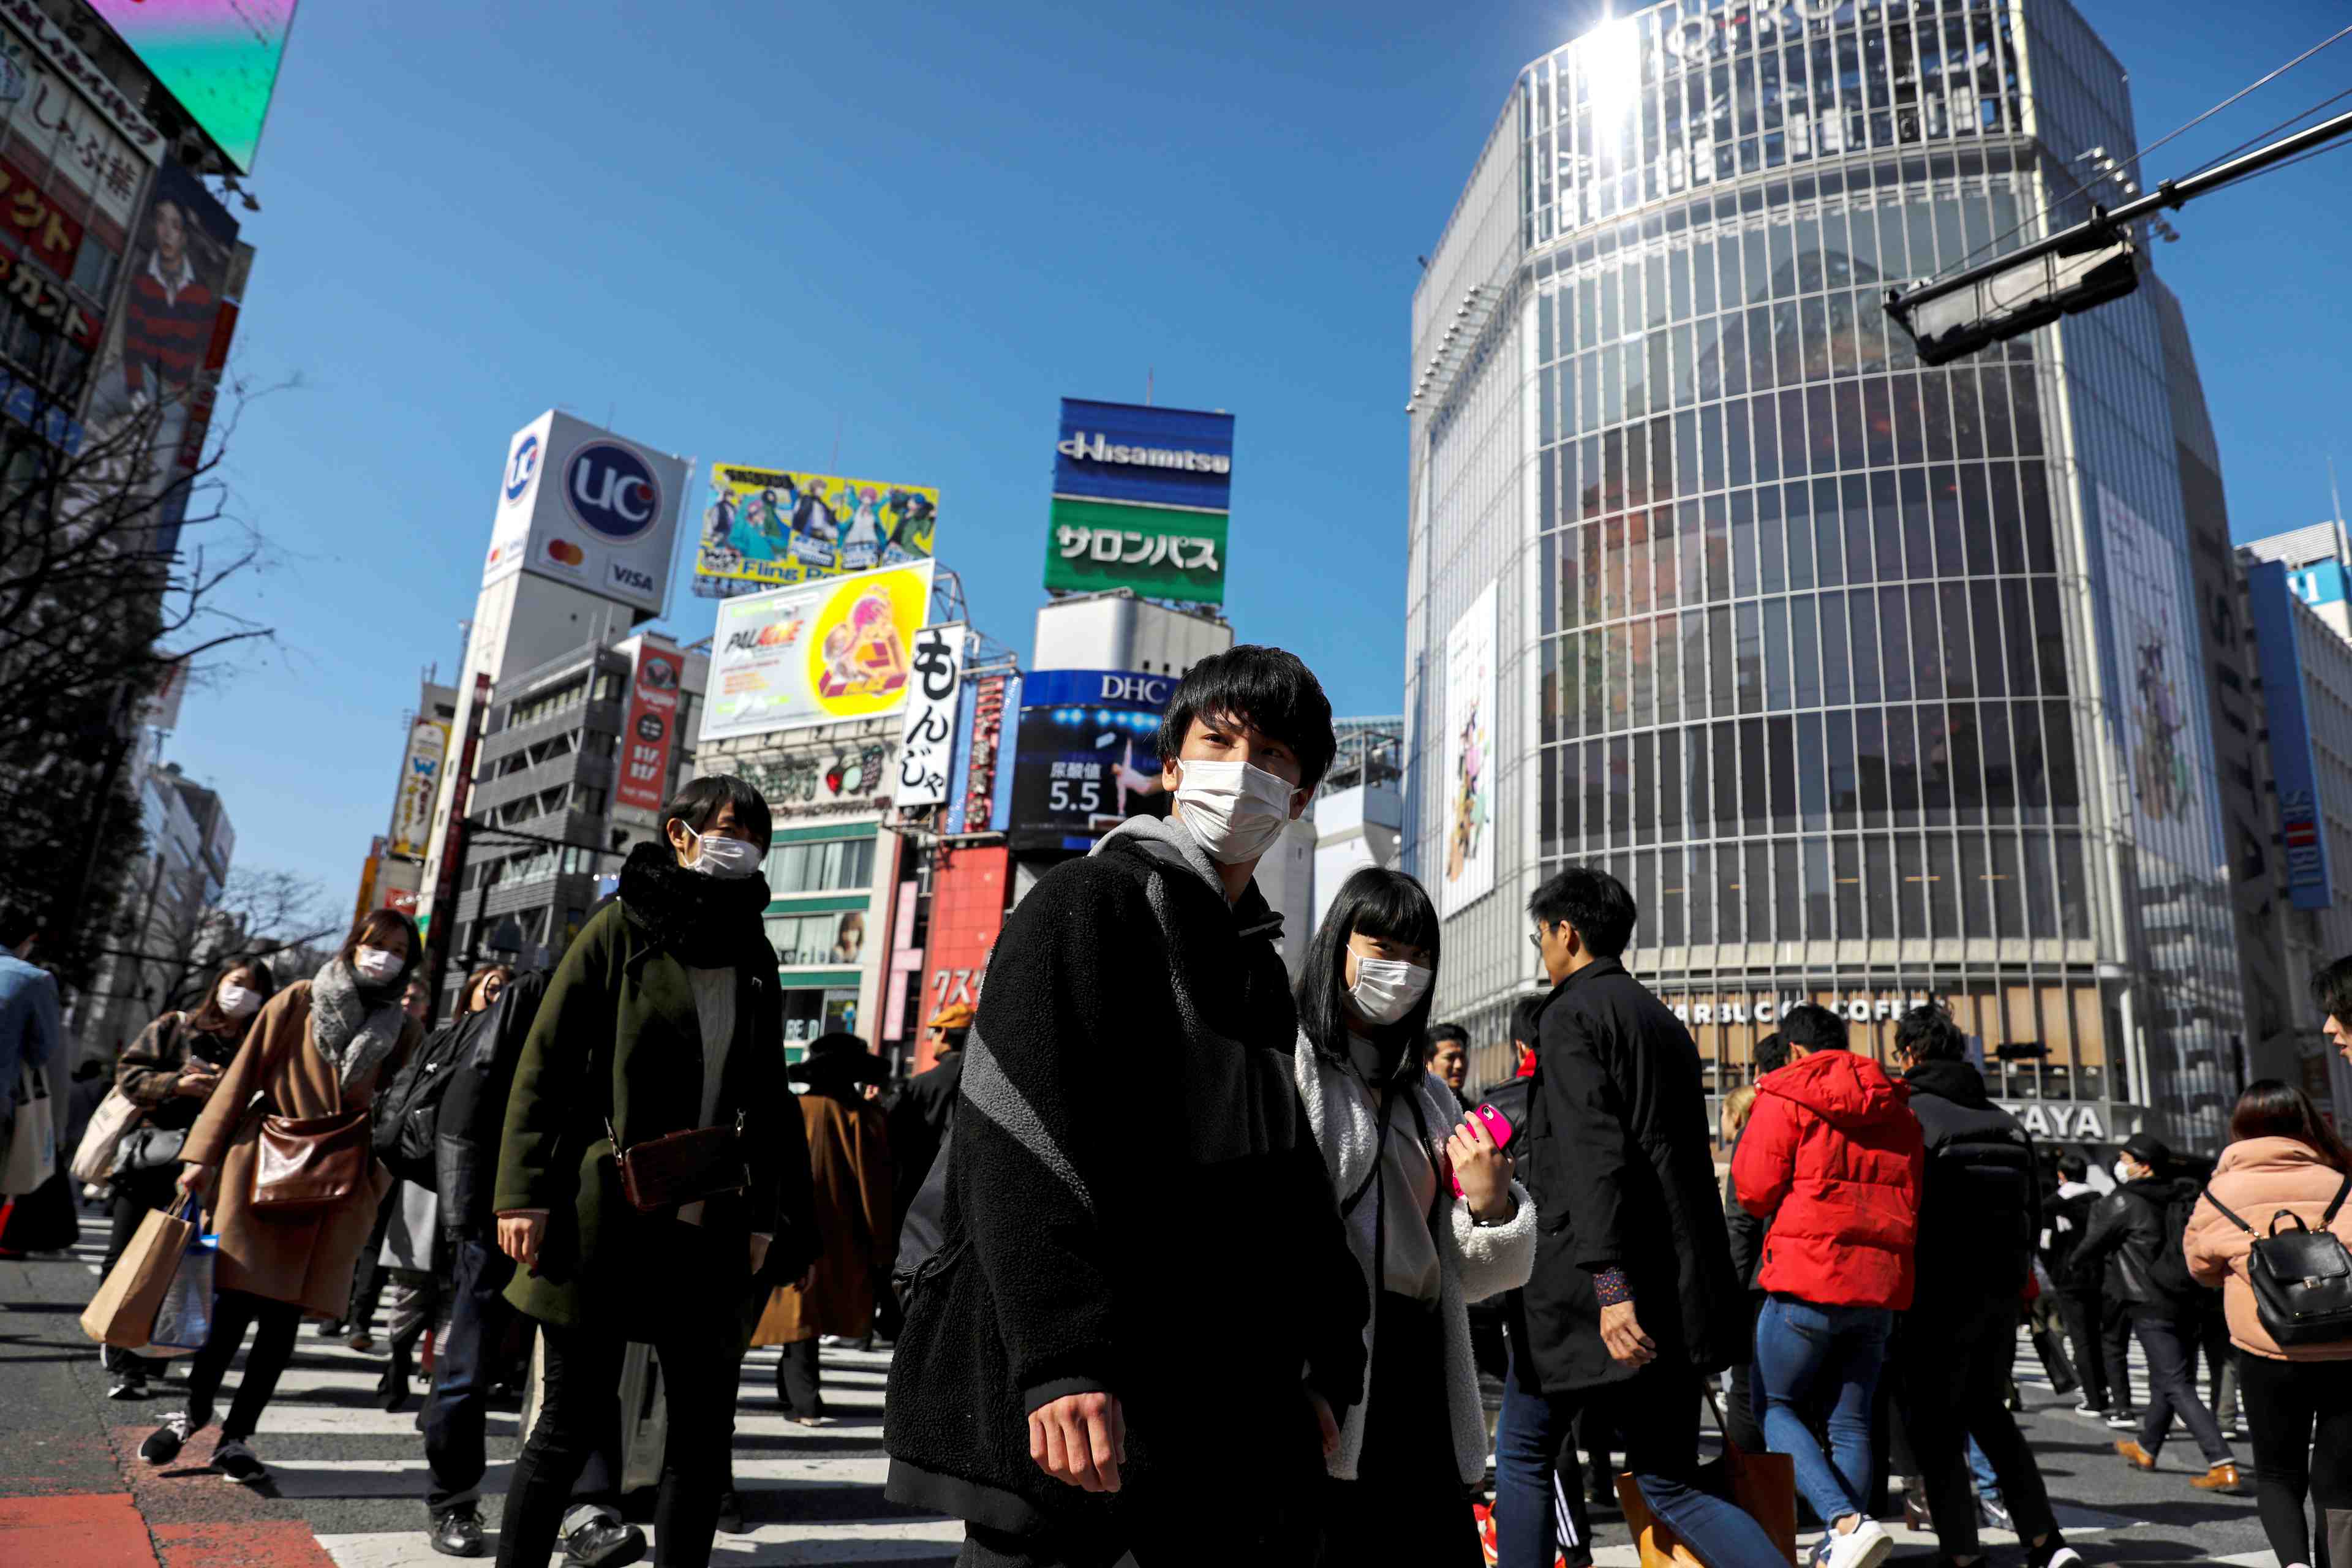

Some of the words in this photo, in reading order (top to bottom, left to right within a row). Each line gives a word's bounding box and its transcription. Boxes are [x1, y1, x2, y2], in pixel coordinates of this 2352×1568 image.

[1057, 431, 1230, 474] Hisamitsu
[1057, 524, 1219, 572] サロンパス
[613, 563, 654, 592] VISA
[1100, 674, 1167, 705] DHC
[901, 630, 956, 798] もんじゃ
[1049, 781, 1101, 812] 5.5
[1667, 1000, 1809, 1026] ARBUC
[1830, 998, 1945, 1022] COFF
